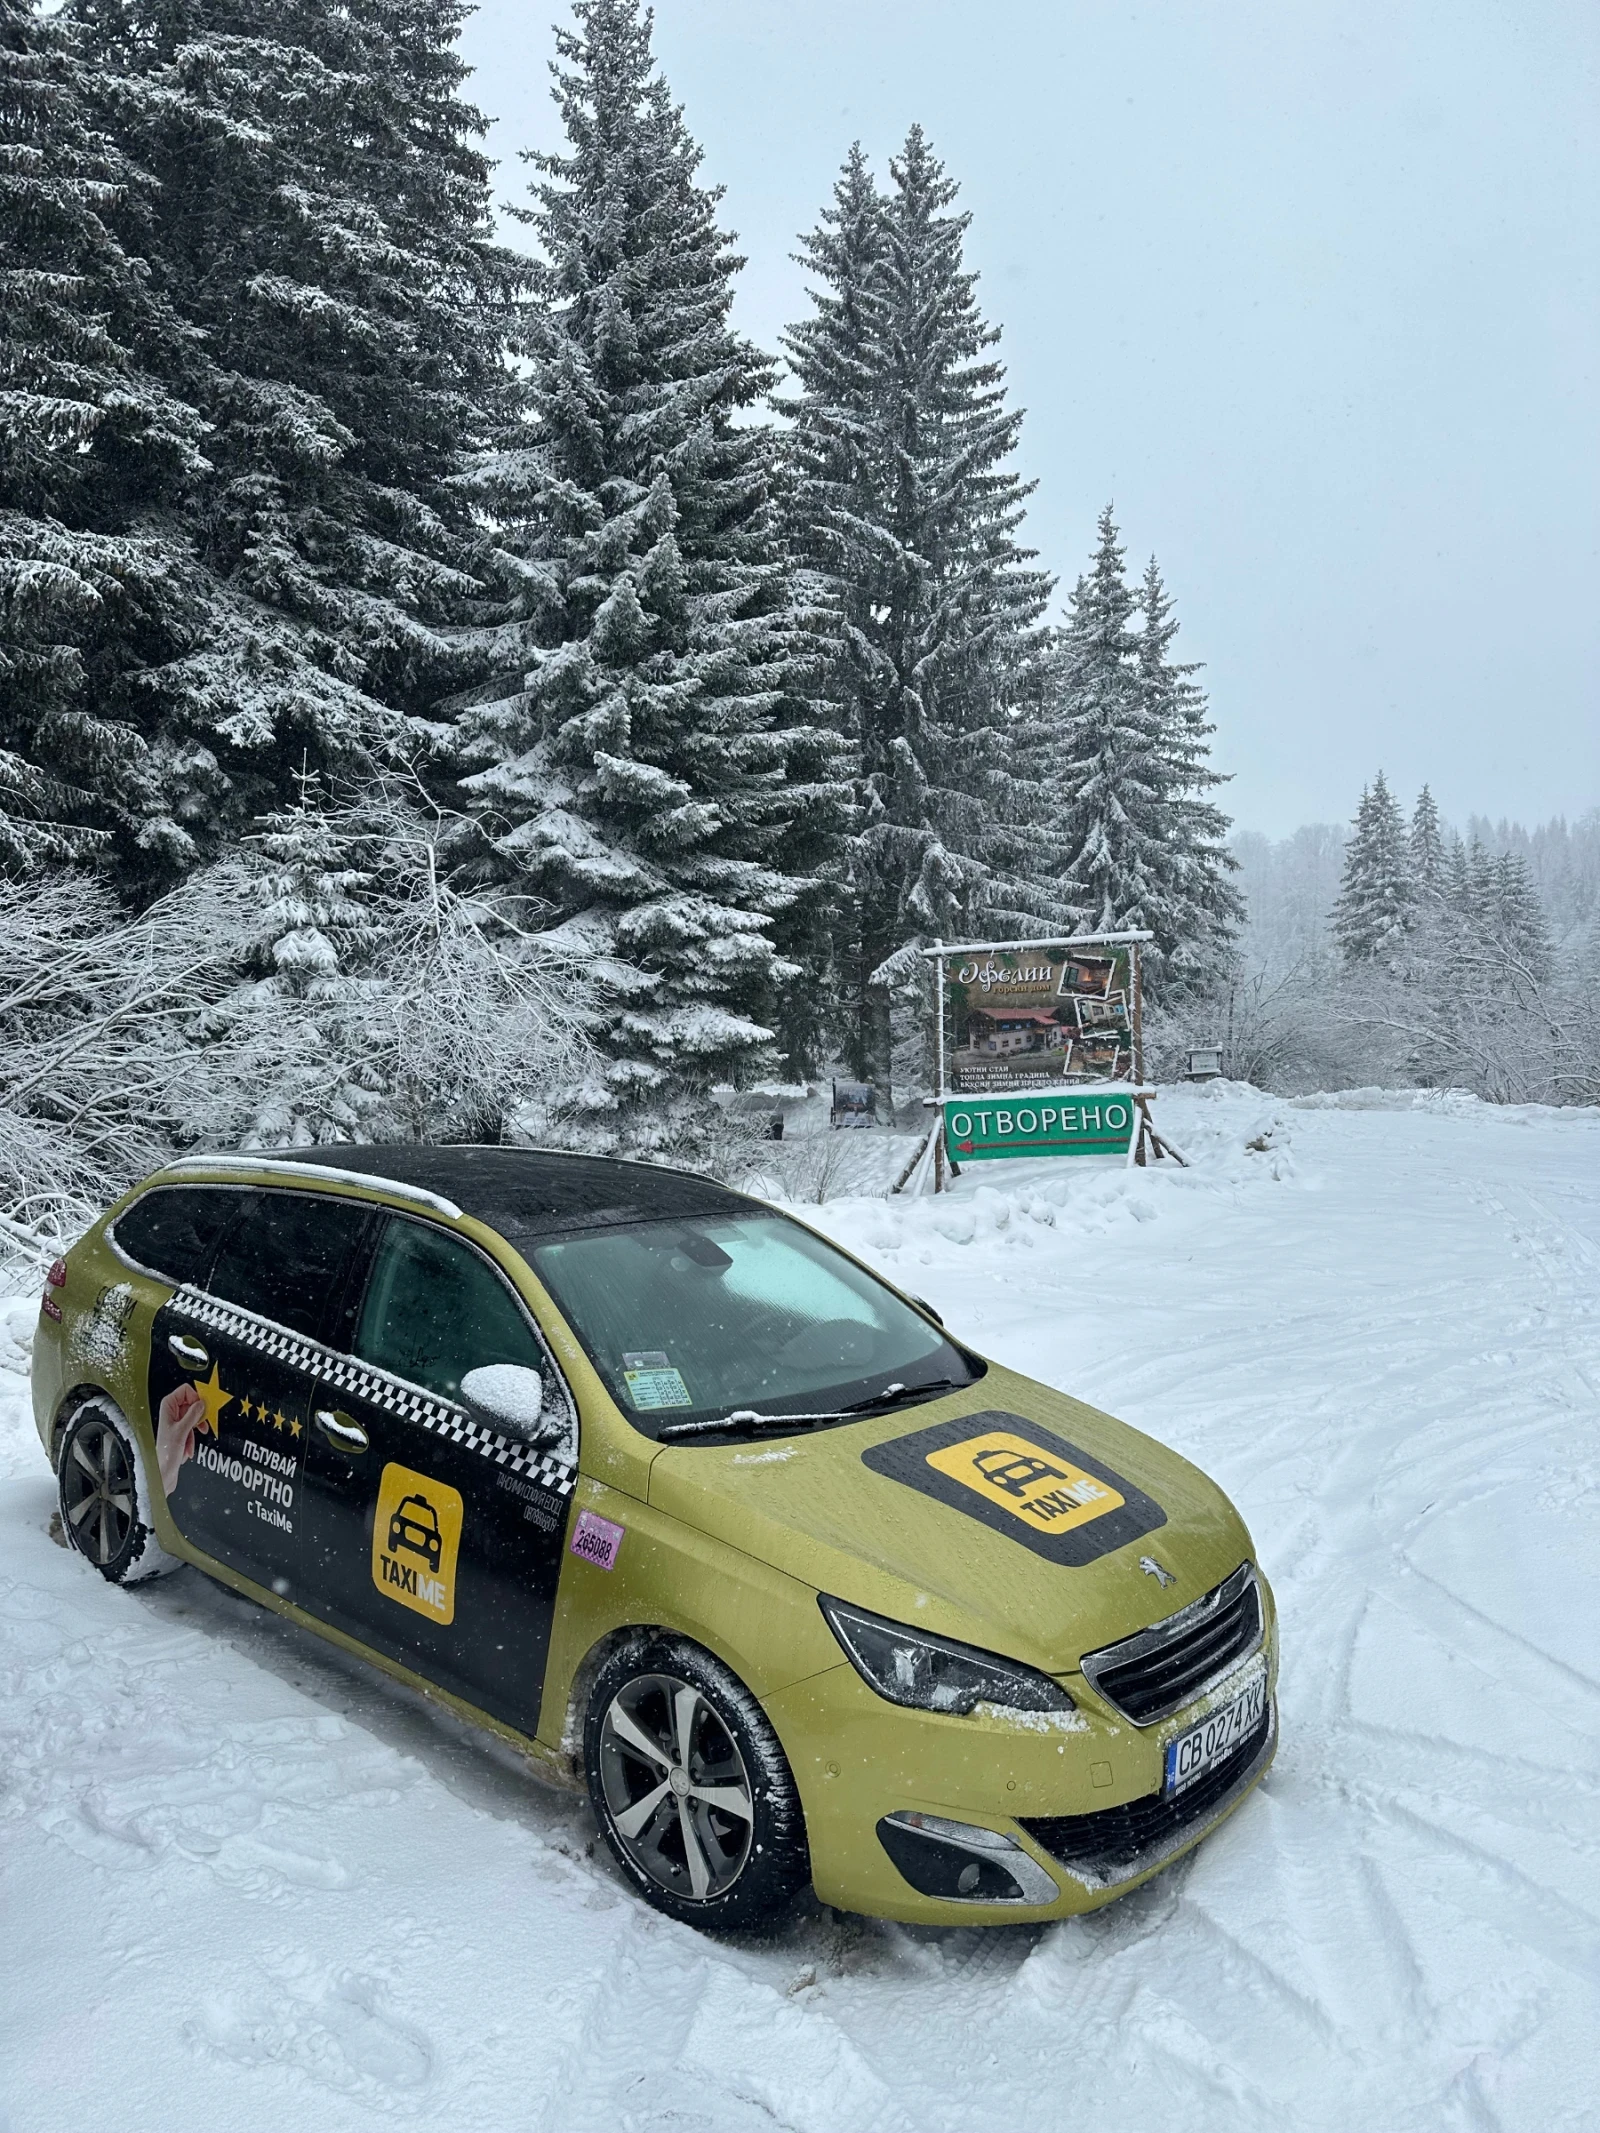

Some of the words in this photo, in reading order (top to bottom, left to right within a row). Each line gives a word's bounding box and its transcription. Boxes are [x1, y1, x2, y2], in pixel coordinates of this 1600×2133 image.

[958, 960, 1053, 993] Офелии
[960, 1066, 988, 1074] УЮТНИ
[960, 1073, 985, 1081] ТОПЛА
[1015, 1071, 1051, 1079] ГРАДИНА
[951, 1104, 1128, 1138] ОТВОРЕНО
[196, 1443, 294, 1508] КОМФОРТНО
[242, 1439, 298, 1479] ПЪТУВАЙ
[255, 1500, 293, 1534] TaxiMe
[1019, 1479, 1109, 1522] TAXIME
[575, 1529, 613, 1562] 265088
[380, 1553, 446, 1611] TAXIME
[1179, 1732, 1203, 1776] CB
[1206, 1700, 1244, 1758] 0274
